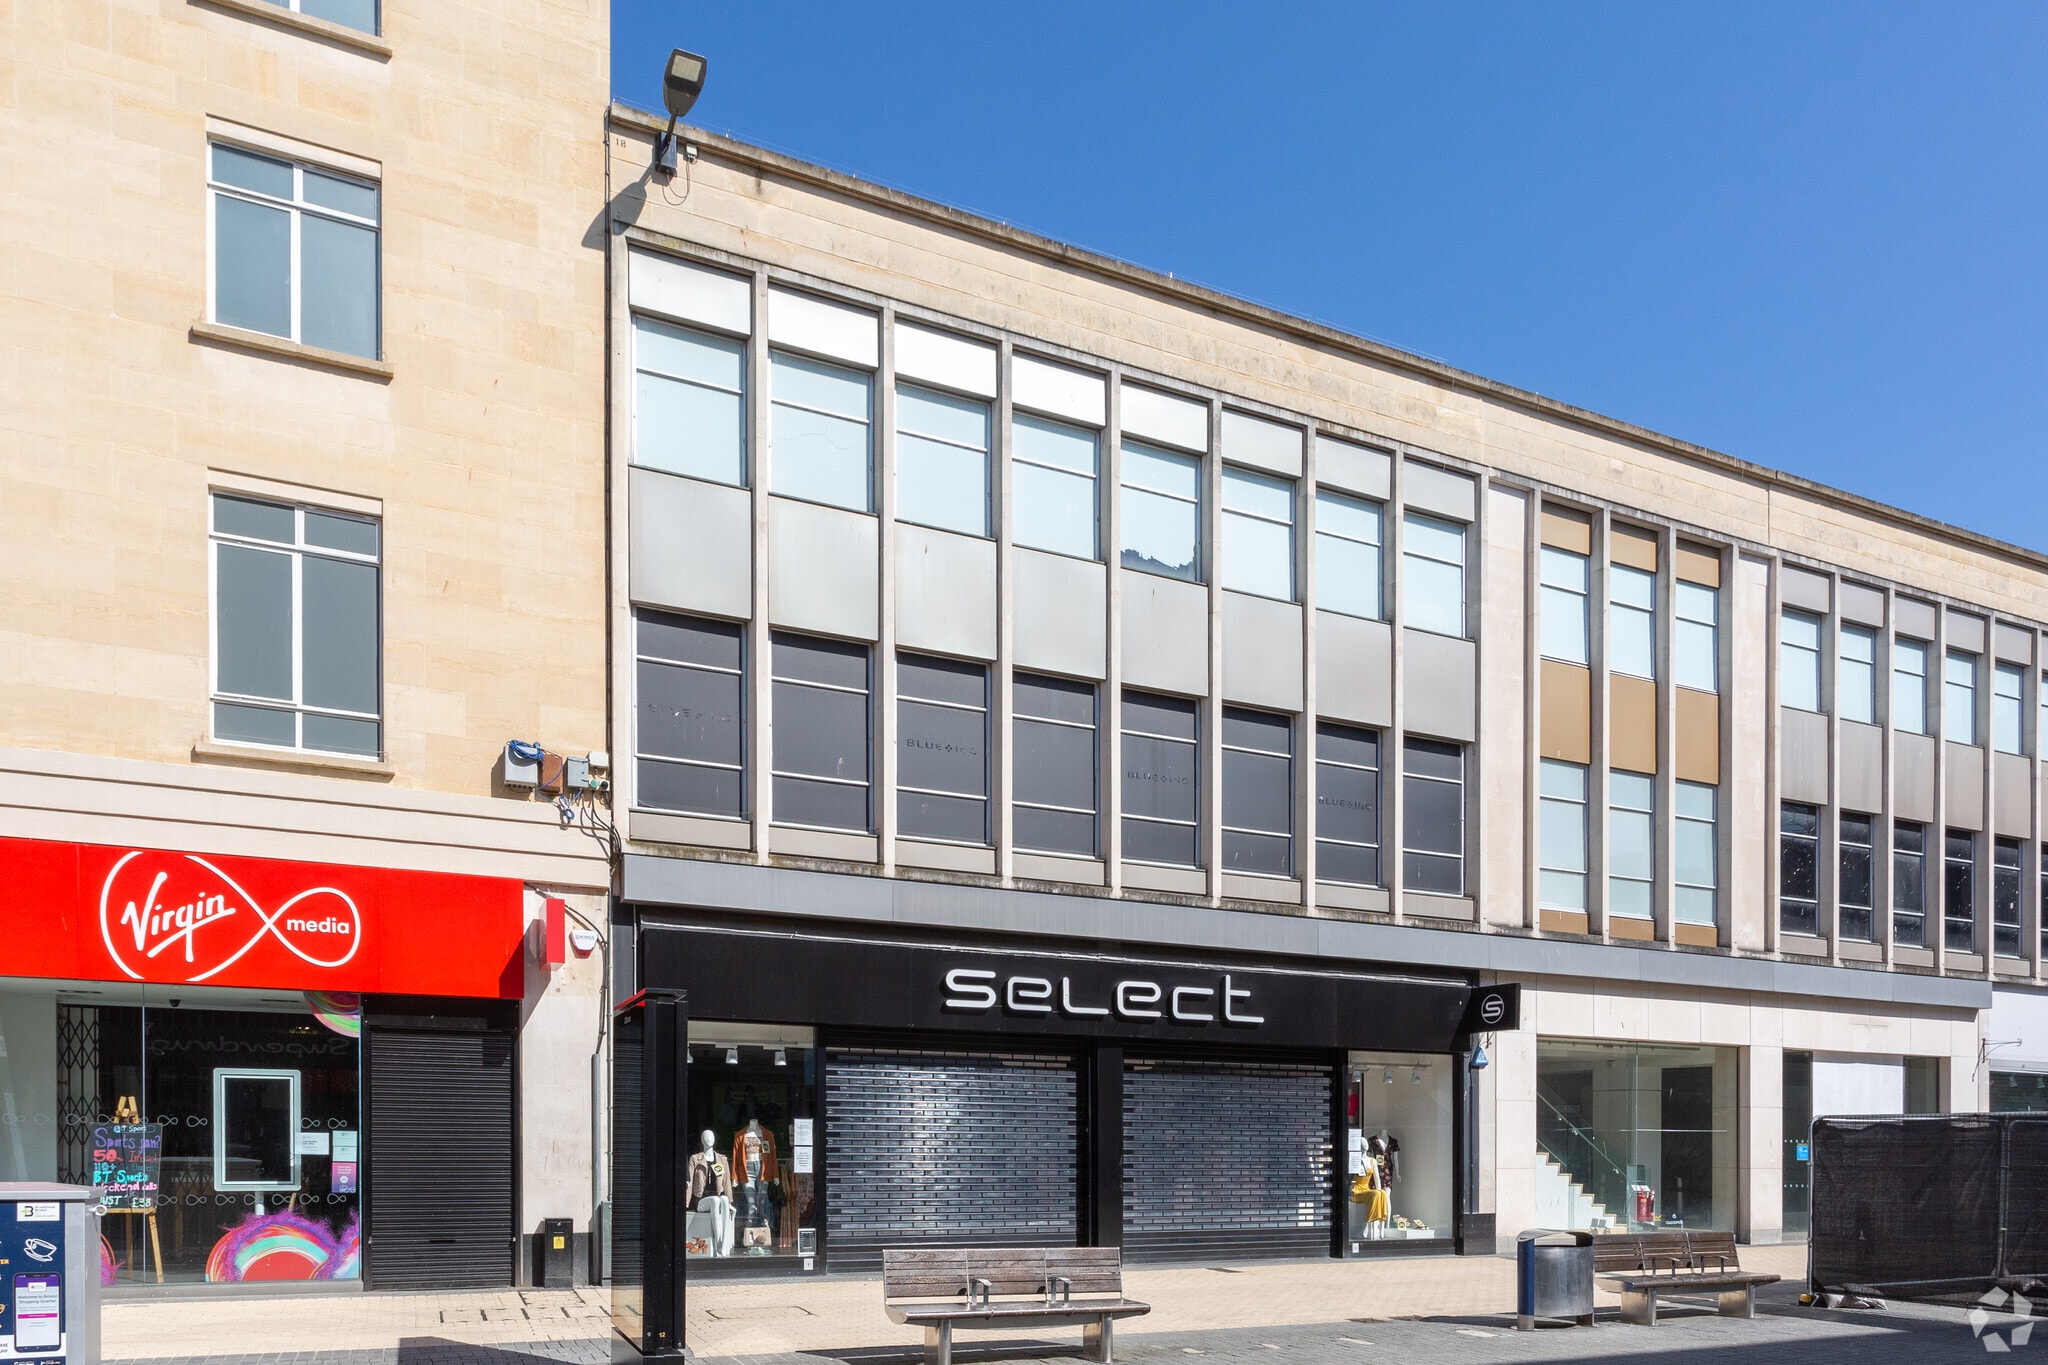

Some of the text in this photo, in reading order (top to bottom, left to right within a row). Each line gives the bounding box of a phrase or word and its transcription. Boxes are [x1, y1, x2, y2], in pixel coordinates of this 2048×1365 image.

[615, 138, 627, 148] 18
[120, 871, 236, 963] Virgin
[286, 917, 350, 935] media
[95, 1127, 135, 1151] Sports
